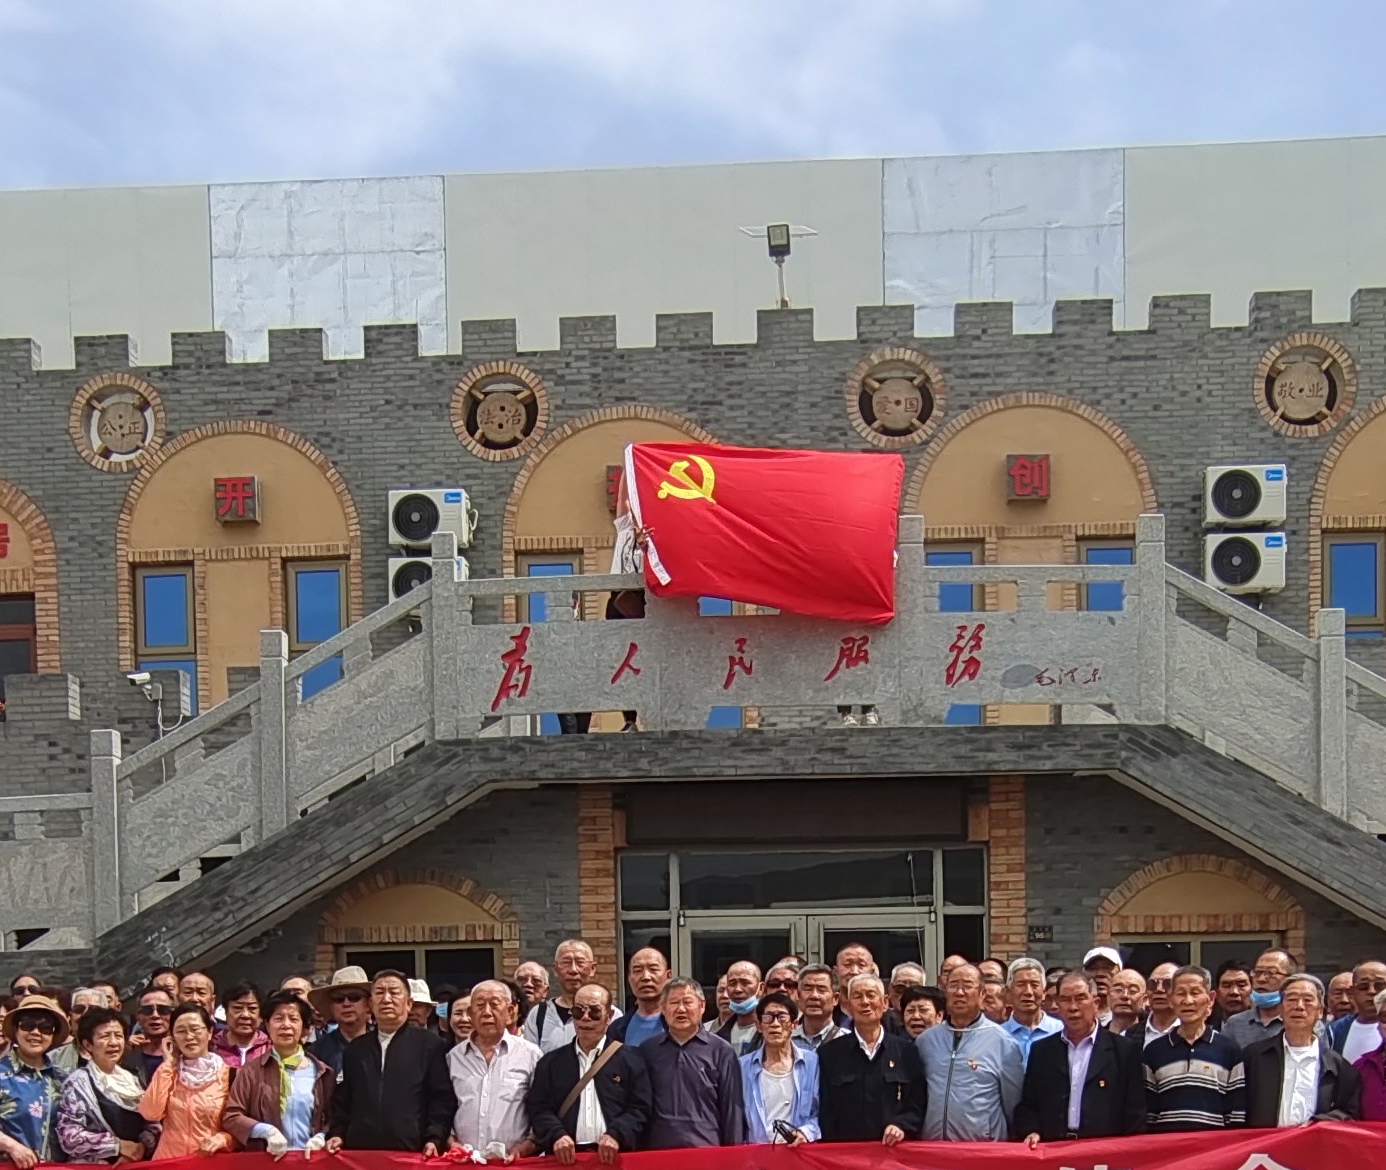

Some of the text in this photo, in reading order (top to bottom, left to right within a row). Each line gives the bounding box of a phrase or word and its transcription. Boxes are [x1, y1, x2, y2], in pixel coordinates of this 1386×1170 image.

[1278, 381, 1324, 400] 敬业
[1009, 456, 1050, 497] 创
[216, 477, 254, 517] 开
